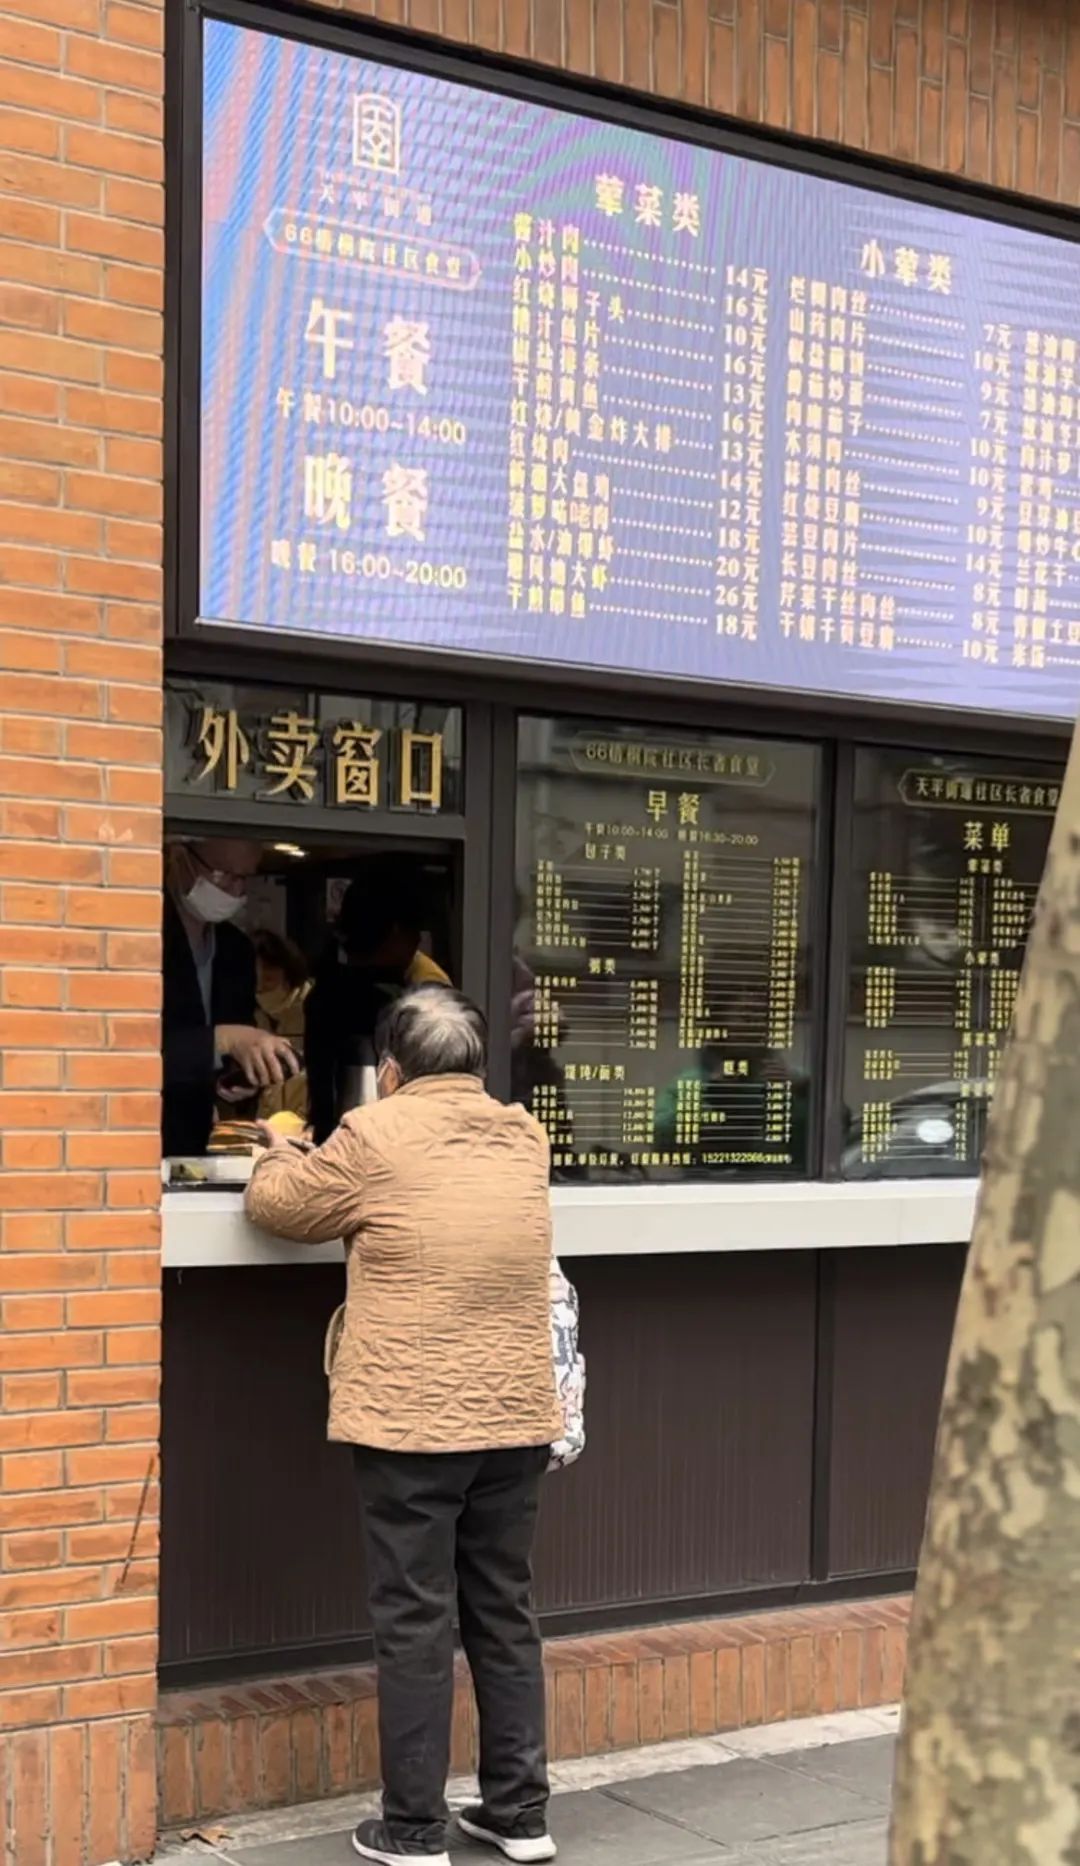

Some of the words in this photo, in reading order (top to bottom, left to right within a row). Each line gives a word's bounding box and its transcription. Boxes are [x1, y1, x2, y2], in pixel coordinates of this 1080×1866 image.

[725, 264, 768, 296] 14元
[725, 293, 768, 325] 16元
[304, 296, 431, 396] 午餐
[724, 322, 767, 354] 10元
[983, 323, 1012, 350] 7元
[723, 352, 766, 383] 16元
[723, 381, 765, 412] 13元
[980, 380, 1011, 407] 9元
[722, 410, 764, 441] 16元
[980, 409, 1009, 436] 7元
[720, 439, 763, 470] 13元
[970, 437, 1007, 466] 10元
[720, 468, 762, 498] 14元
[969, 466, 1006, 494] 10元
[304, 452, 430, 541] 晚餐
[976, 496, 1005, 522] 9元
[719, 498, 761, 526] 12元
[718, 526, 760, 555] 18元
[715, 555, 759, 584] 20元
[965, 552, 1003, 579] 14元
[715, 584, 758, 612] 26元
[715, 613, 758, 641] 18元
[198, 706, 443, 808] 外卖窗口
[646, 790, 700, 825] 早餐
[963, 821, 1011, 852] 菜单
